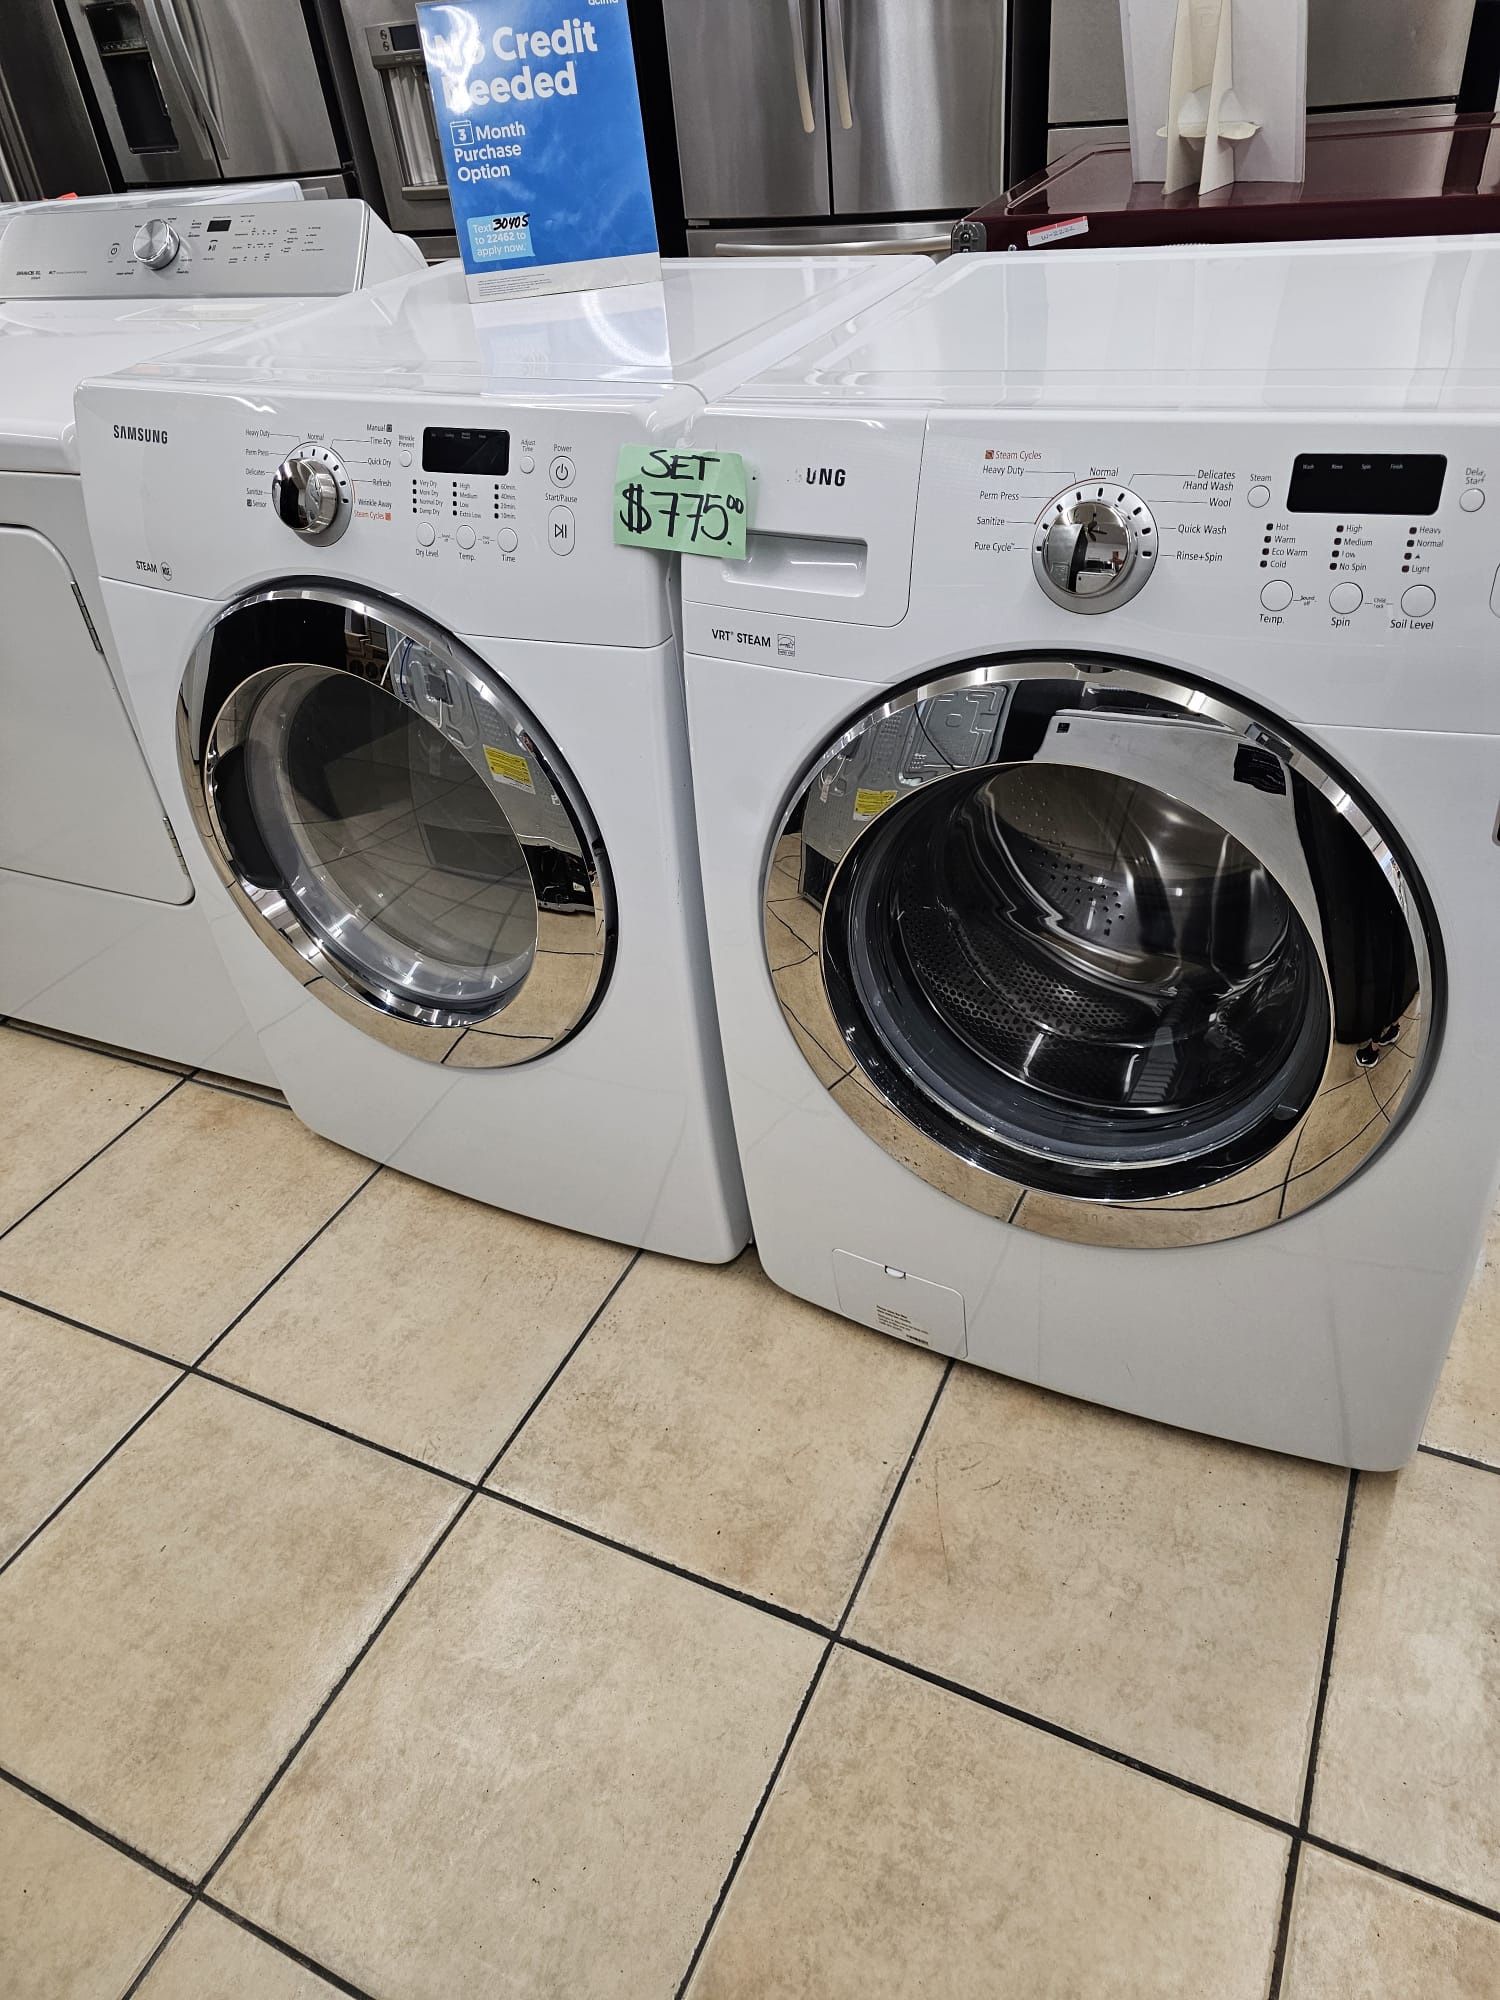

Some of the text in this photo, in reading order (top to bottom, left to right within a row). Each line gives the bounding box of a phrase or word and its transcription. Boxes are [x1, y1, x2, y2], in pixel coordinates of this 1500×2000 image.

[493, 18, 598, 61] Credit
[442, 61, 578, 109] Needed
[476, 121, 526, 141] Month
[455, 143, 522, 163] Purchase
[457, 165, 511, 184] Option
[473, 224, 491, 234] Text
[474, 232, 527, 245] to 22462 to
[477, 246, 502, 257] apply
[367, 424, 386, 432] Manual
[113, 425, 168, 445] SAMSUNG
[245, 428, 270, 439] Heavy Duty
[307, 432, 324, 441] Normal
[370, 437, 392, 447] Time Dry
[553, 444, 572, 453] Power
[995, 450, 1042, 462] Steam Cycles
[368, 458, 391, 467] Quick Dry
[641, 450, 720, 480] SET
[983, 465, 1025, 476] Heavy Duty
[1090, 467, 1119, 477] Normal
[1198, 470, 1236, 480] Delicates
[1250, 473, 1272, 482] Steam
[372, 479, 391, 487] Refresh
[1182, 481, 1234, 491] /Hand Wash
[544, 492, 578, 504] Start/Pause
[980, 491, 1019, 500] Perm Press
[358, 498, 392, 509] Wrinkle Away
[1209, 498, 1232, 507] Wool
[977, 516, 1005, 525] Sanitize
[1178, 523, 1227, 534] Quick Wash
[1276, 522, 1289, 531] Hot
[1346, 524, 1363, 535] High
[1419, 526, 1441, 535] Heavy
[1274, 536, 1296, 544] Warm
[1343, 538, 1373, 547] Medium
[1416, 539, 1444, 548] Normal
[974, 542, 991, 551] Pure
[415, 549, 439, 558] Dry Level
[1272, 548, 1308, 557] Eco Warm
[136, 560, 157, 573] STEAM
[1270, 560, 1287, 568] Cold
[1339, 562, 1367, 573] No Spin
[1411, 564, 1430, 574] Light
[1331, 617, 1351, 628] Spin
[1390, 619, 1434, 630] Soil Level
[737, 632, 771, 648] STEAM
